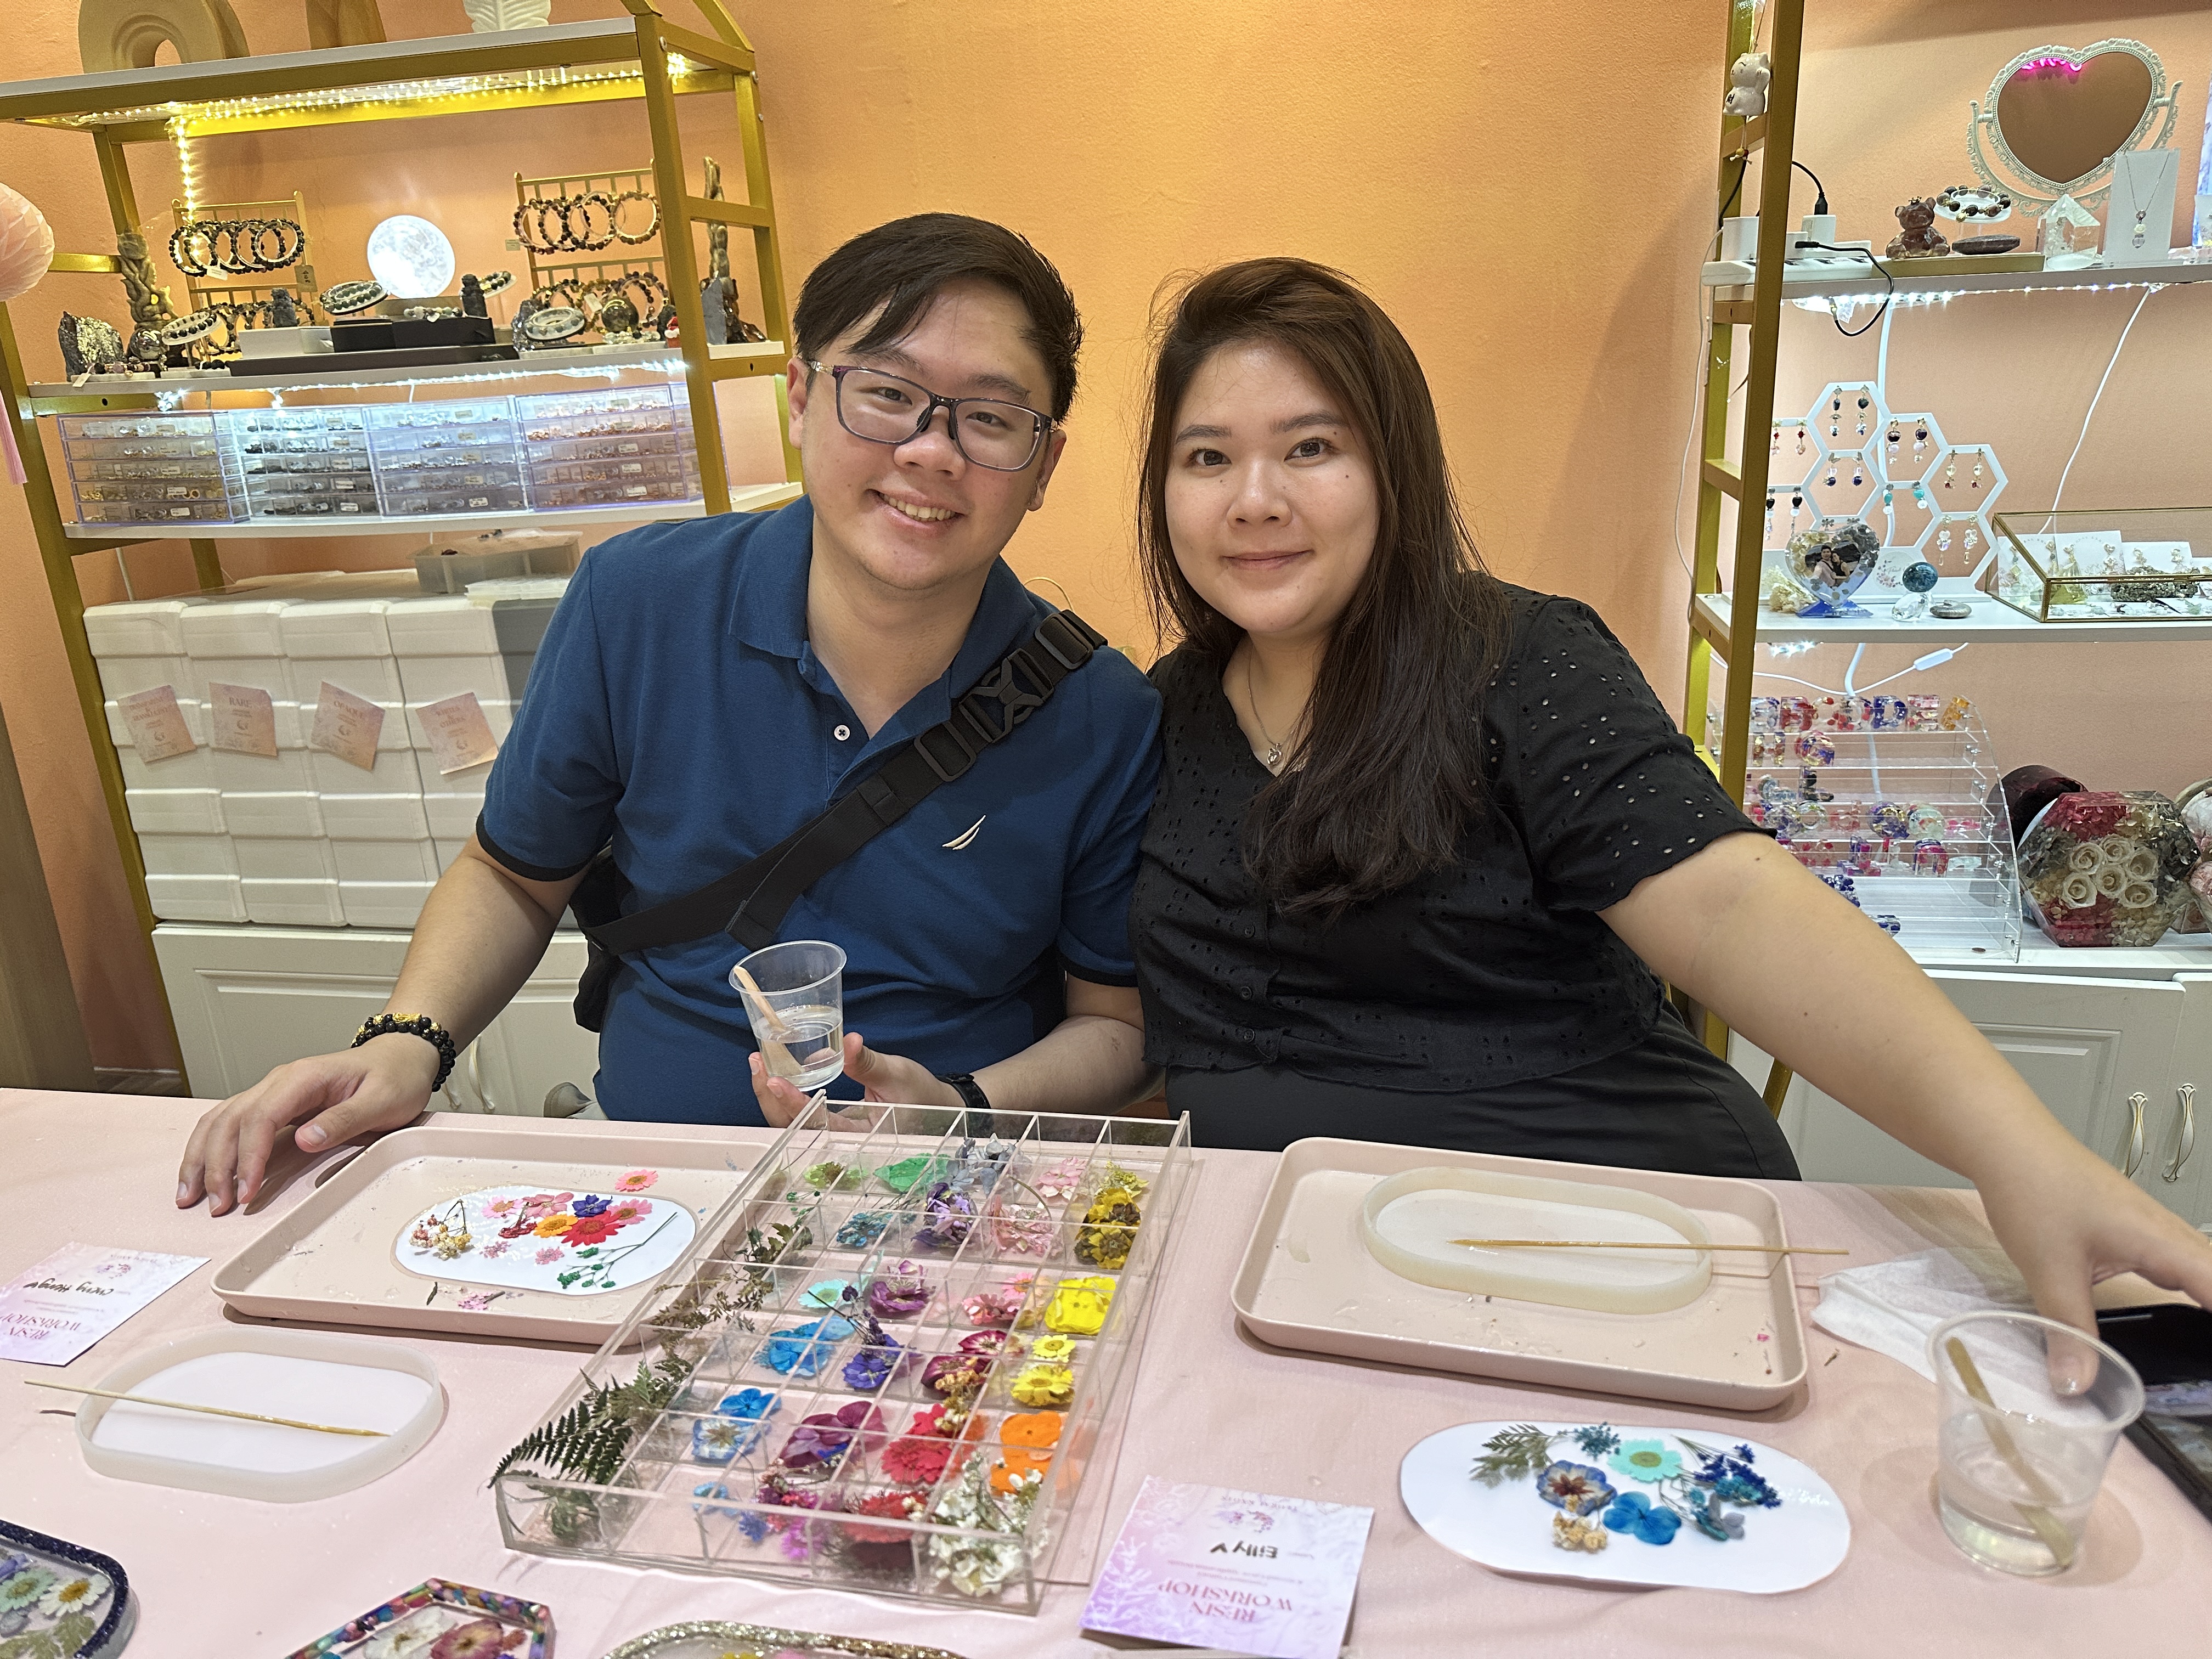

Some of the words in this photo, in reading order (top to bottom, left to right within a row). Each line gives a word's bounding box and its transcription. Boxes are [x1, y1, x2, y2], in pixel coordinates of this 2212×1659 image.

[8, 1326, 49, 1340] RESIN
[1233, 1540, 1278, 1559] Eilly
[1158, 1579, 1293, 1611] WORKSHOP
[1193, 1600, 1256, 1622] RESIN
